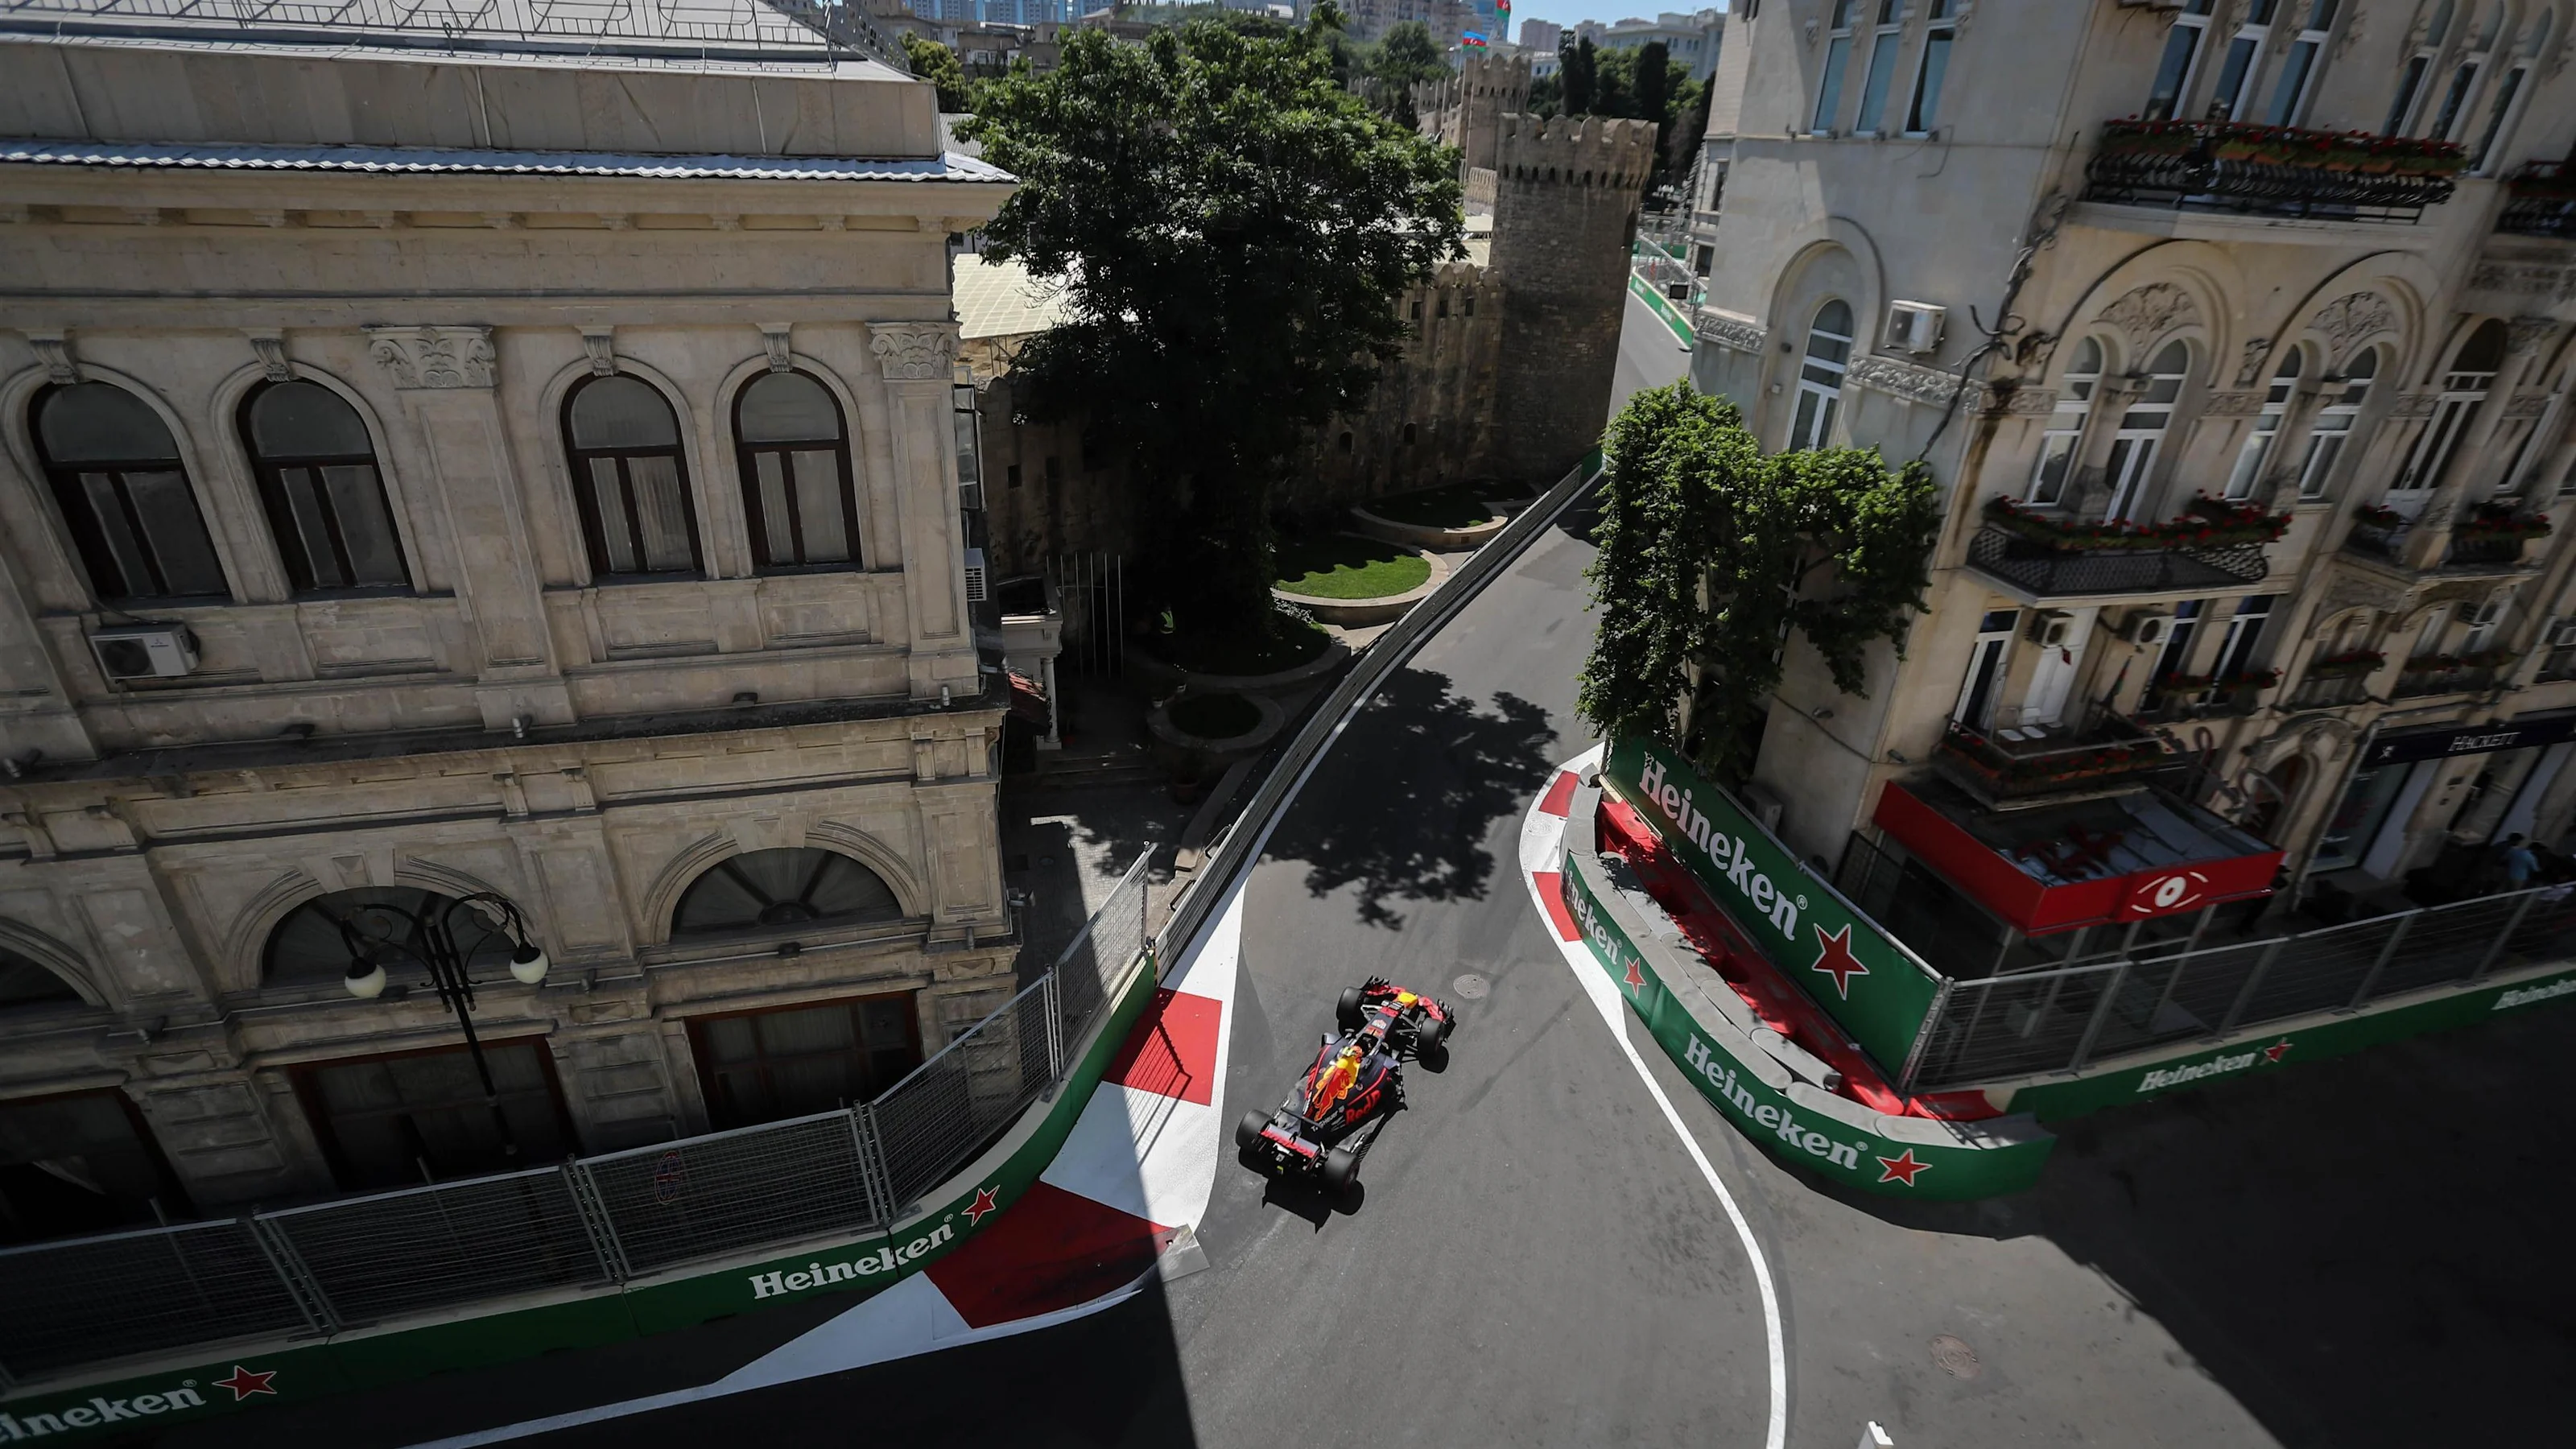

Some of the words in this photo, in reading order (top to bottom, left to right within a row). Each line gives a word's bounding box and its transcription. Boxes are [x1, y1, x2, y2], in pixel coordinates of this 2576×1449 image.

[1639, 751, 1798, 941] Heineken
[1565, 867, 1619, 965] ineken
[1684, 1032, 1860, 1170] Heineken
[2136, 1052, 2257, 1092] Heineken
[749, 1220, 955, 1299] Heineken
[0, 1388, 207, 1443] ineken
